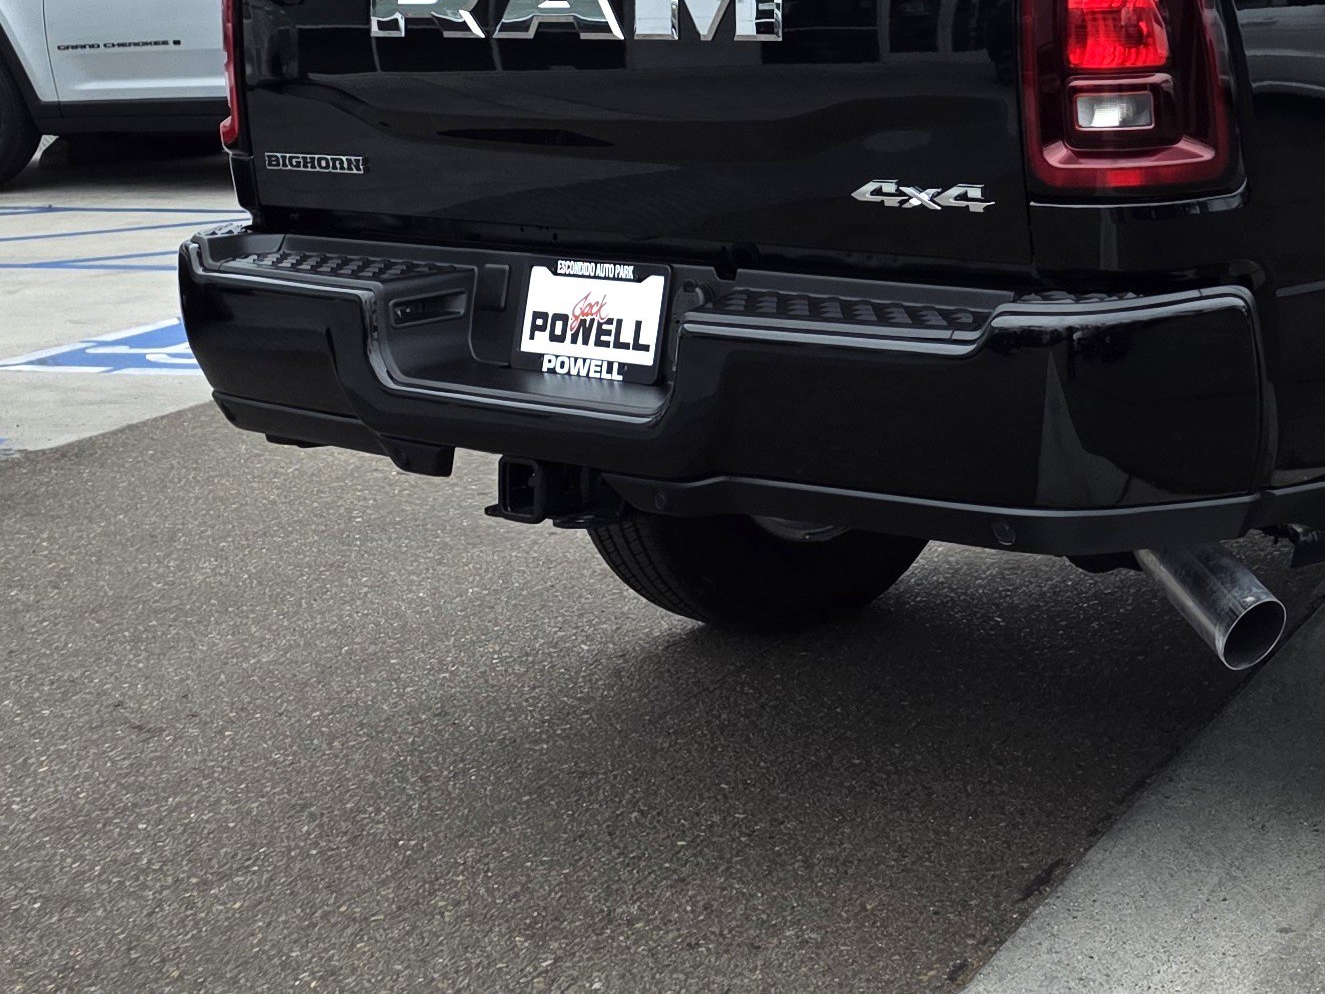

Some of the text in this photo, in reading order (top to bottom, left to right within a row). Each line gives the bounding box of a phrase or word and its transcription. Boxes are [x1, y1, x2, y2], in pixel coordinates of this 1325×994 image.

[103, 40, 169, 49] CHEROKEE
[265, 152, 364, 174] BIGHORN
[557, 260, 634, 279] ESCONDIDO AUTO PARK
[570, 291, 609, 332] Jack
[529, 310, 651, 352] POWELL
[542, 354, 623, 381] POWELL
